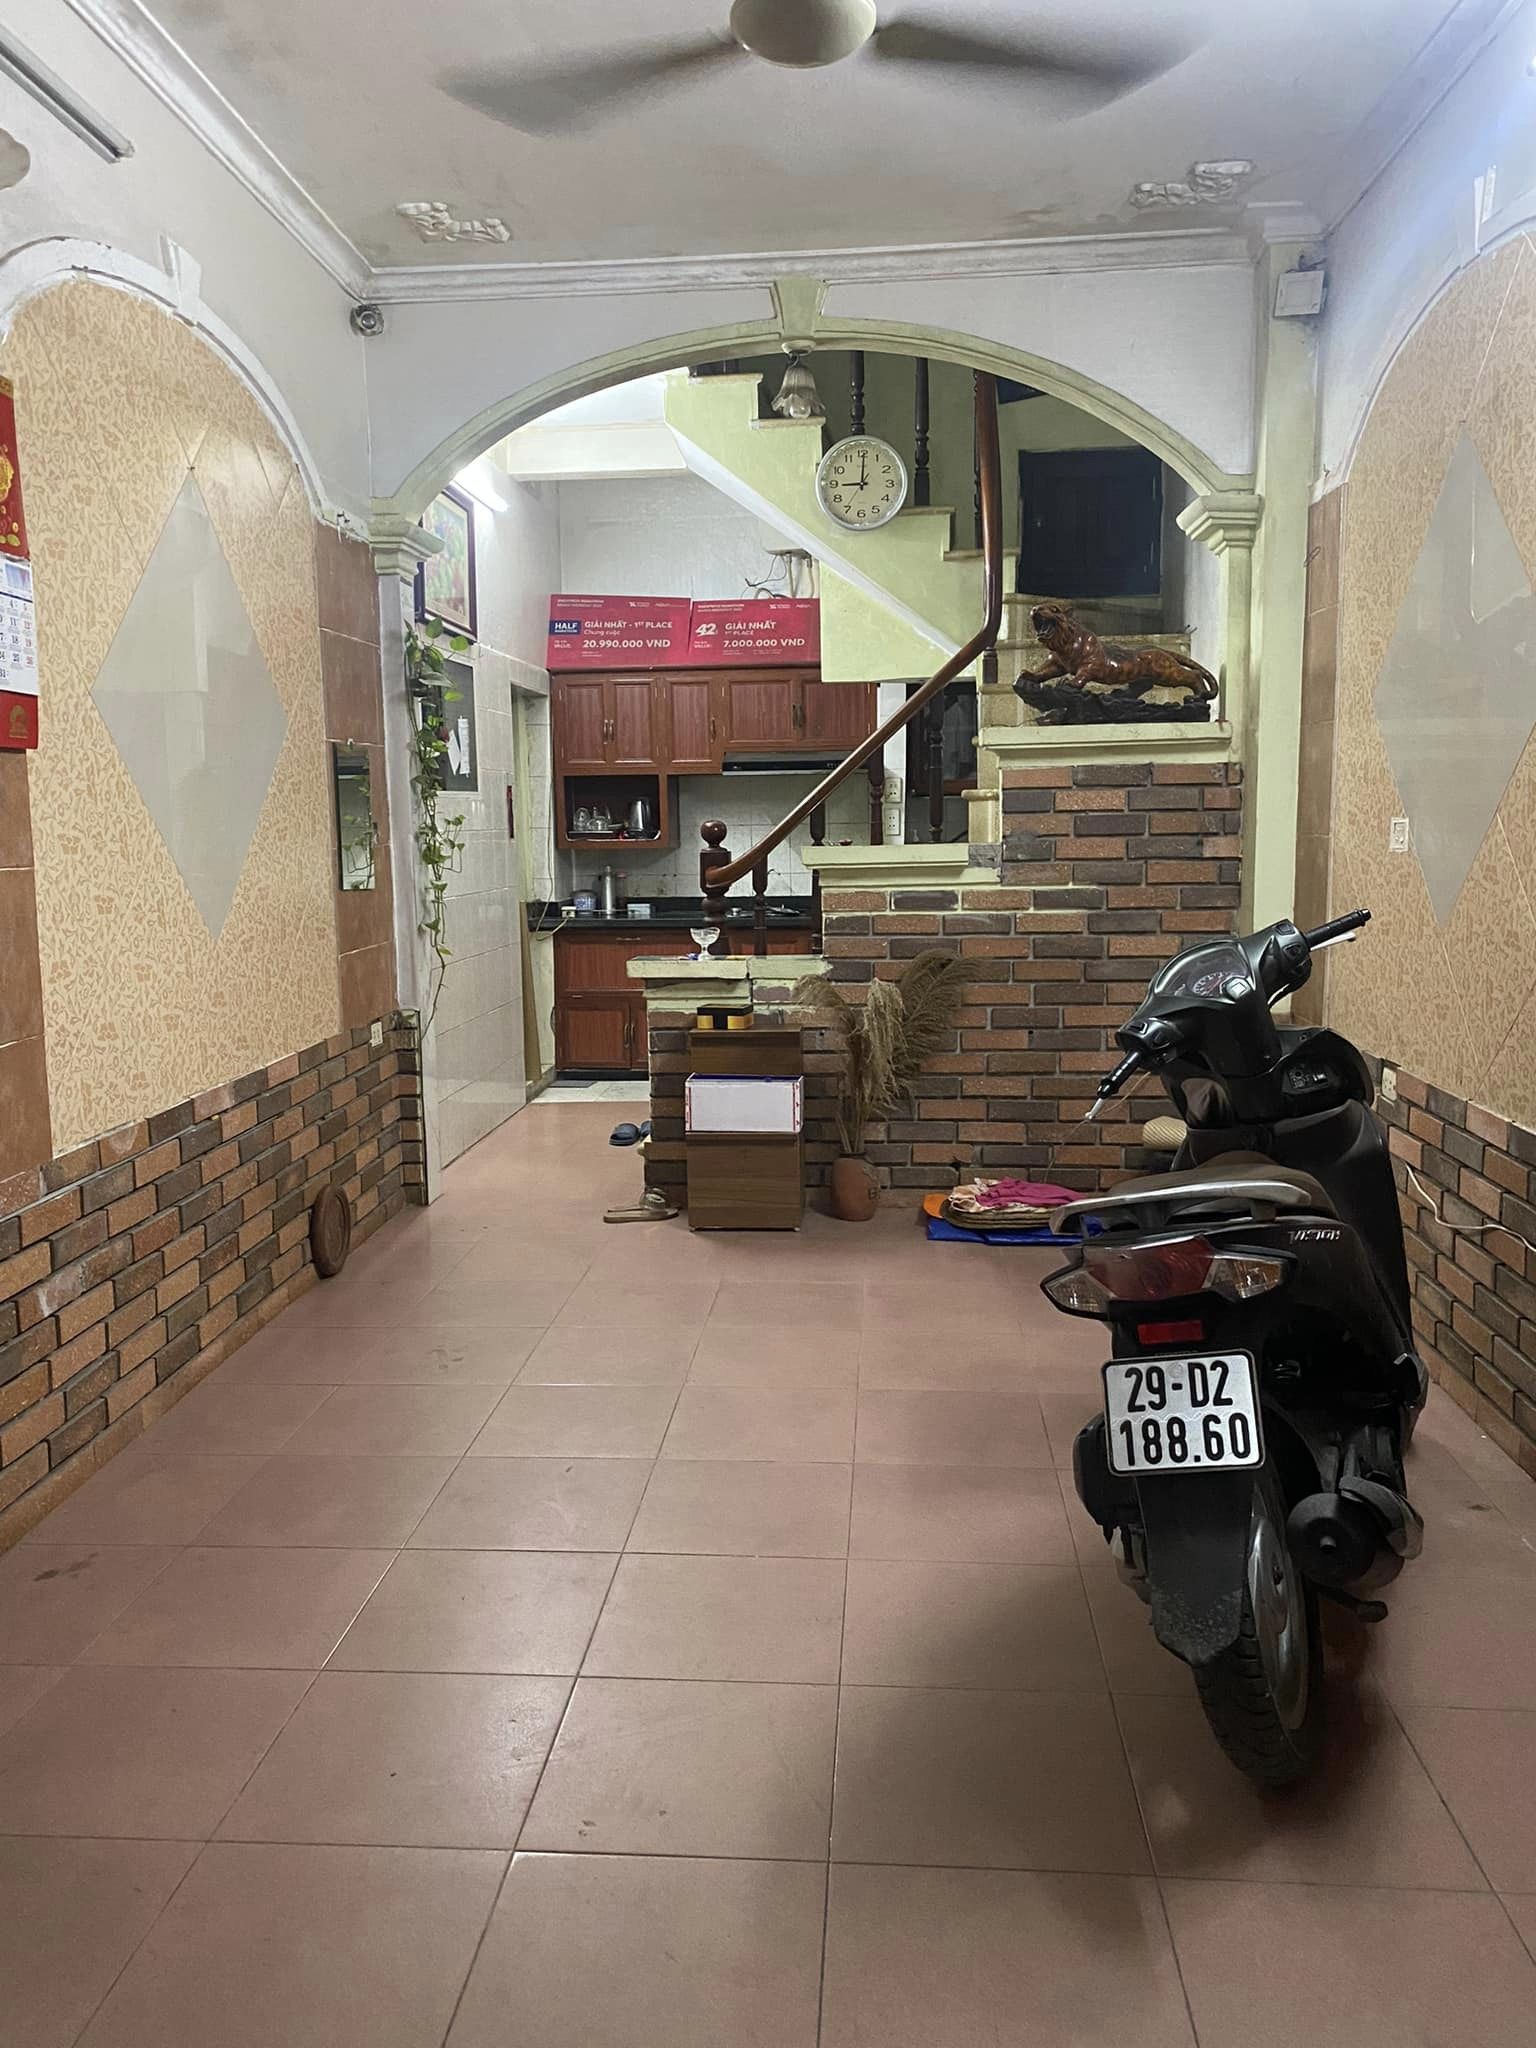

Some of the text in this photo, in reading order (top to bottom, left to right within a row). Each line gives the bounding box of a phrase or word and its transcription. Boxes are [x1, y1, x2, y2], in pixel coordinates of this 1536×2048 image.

[844, 454, 853, 463] 11
[833, 465, 845, 475] 10
[881, 465, 892, 474] 2
[829, 480, 839, 489] 9
[885, 479, 895, 488] 3
[833, 494, 842, 503] 8
[881, 494, 890, 502] 4
[843, 505, 852, 514] 7
[857, 509, 866, 518] 6
[871, 505, 880, 513] 5
[554, 622, 578, 630] HALF
[604, 619, 627, 628] NHẤT
[645, 621, 673, 629] PLACE
[748, 620, 777, 629] NHẤT
[695, 623, 717, 637] 42
[583, 639, 671, 648] 20.990.000 VND
[723, 639, 778, 648] 7.000.000
[780, 638, 805, 646] VND
[1124, 1360, 1233, 1412] 29-D2
[1119, 1412, 1251, 1466] 188.60
